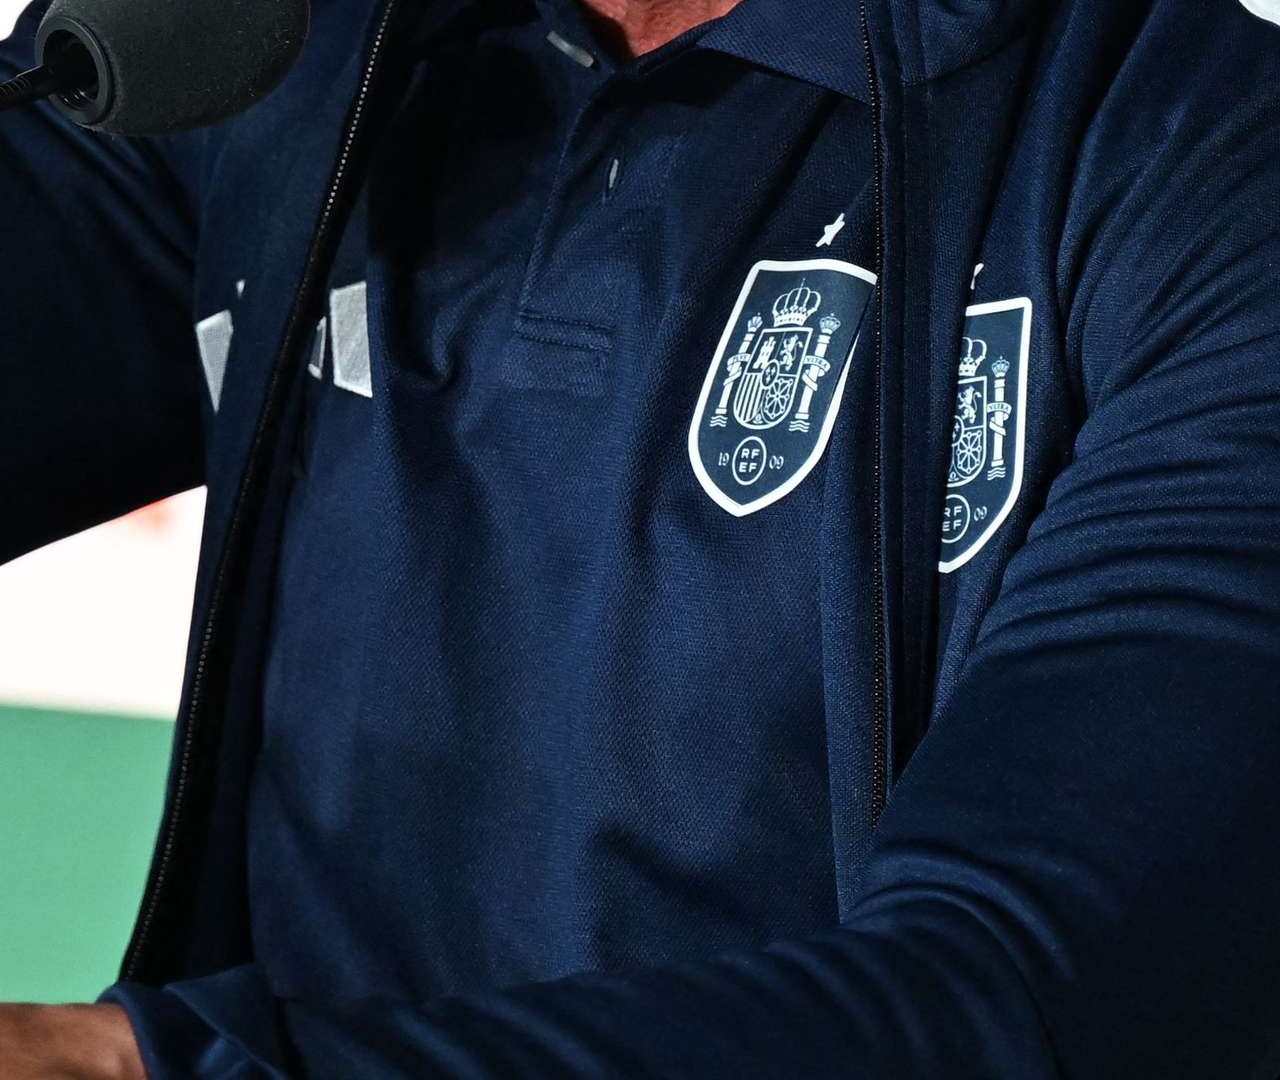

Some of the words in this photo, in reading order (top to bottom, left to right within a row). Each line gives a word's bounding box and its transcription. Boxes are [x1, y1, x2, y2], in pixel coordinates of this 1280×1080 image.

[718, 452, 730, 467] 19
[741, 448, 761, 460] RF
[738, 462, 758, 473] EF
[769, 455, 784, 470] 09
[973, 505, 988, 521] 09
